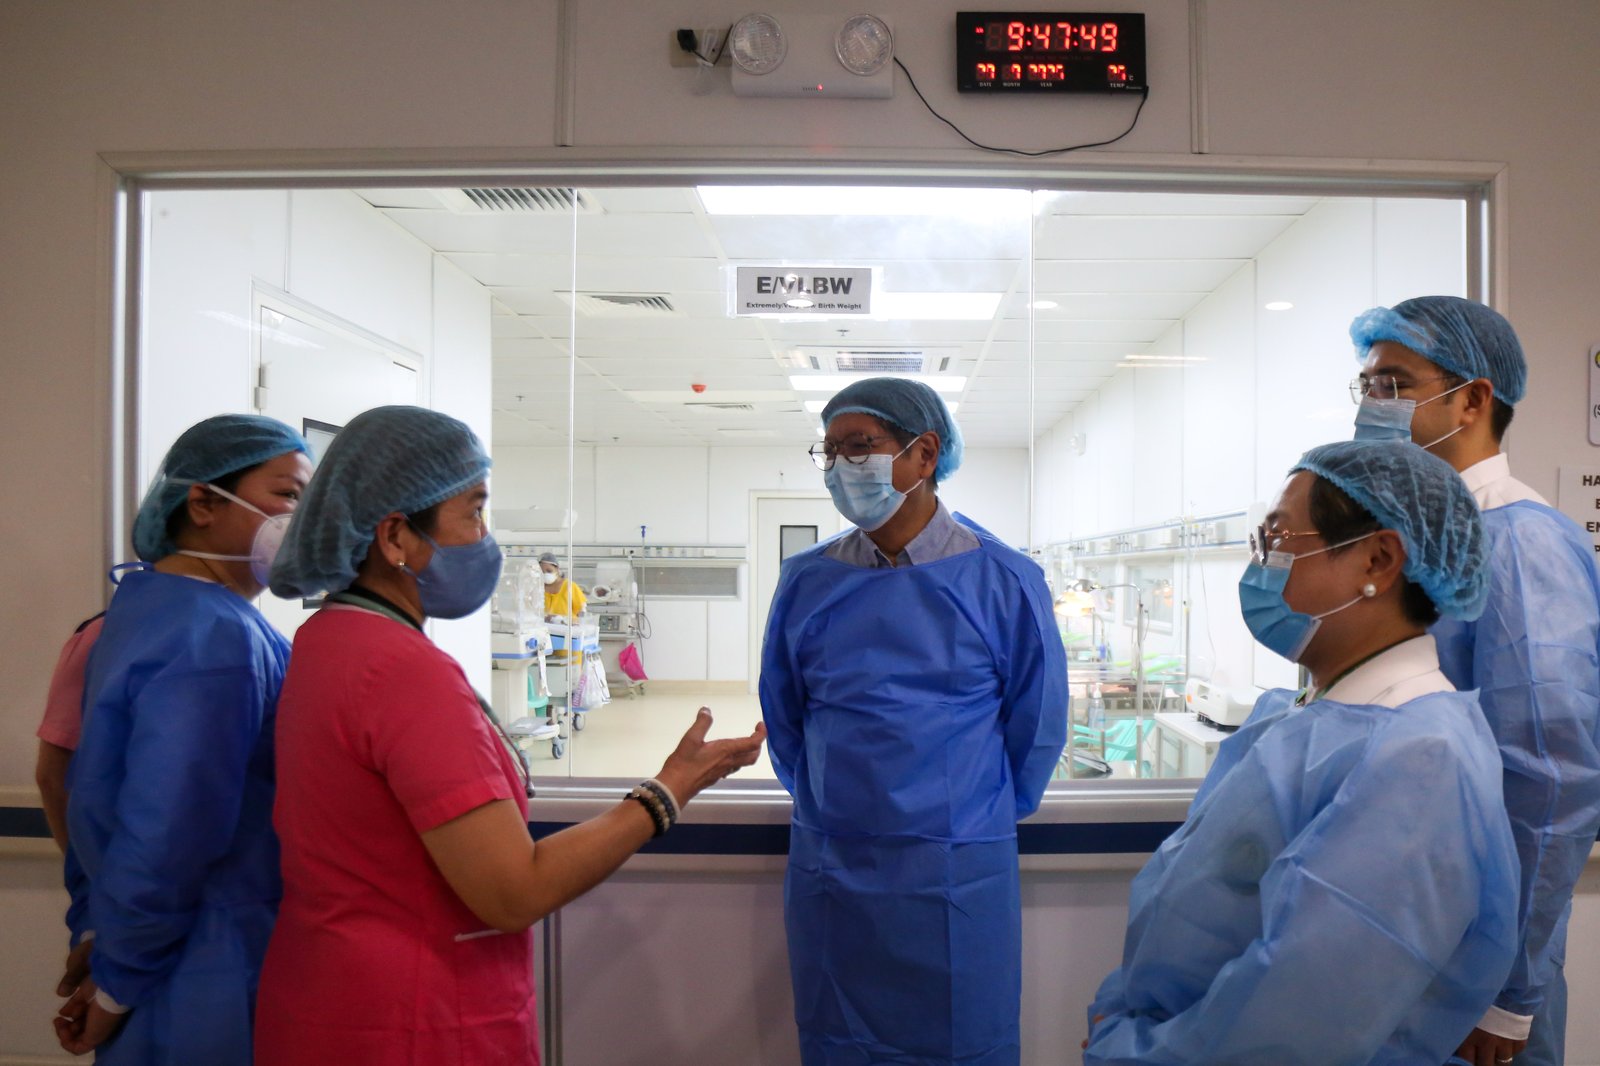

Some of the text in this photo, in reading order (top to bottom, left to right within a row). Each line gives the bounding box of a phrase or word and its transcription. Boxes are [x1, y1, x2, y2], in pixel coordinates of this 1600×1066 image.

[1007, 22, 1118, 52] 9:47:49
[756, 276, 853, 295] E/VLBW
[837, 303, 862, 311] Weight
